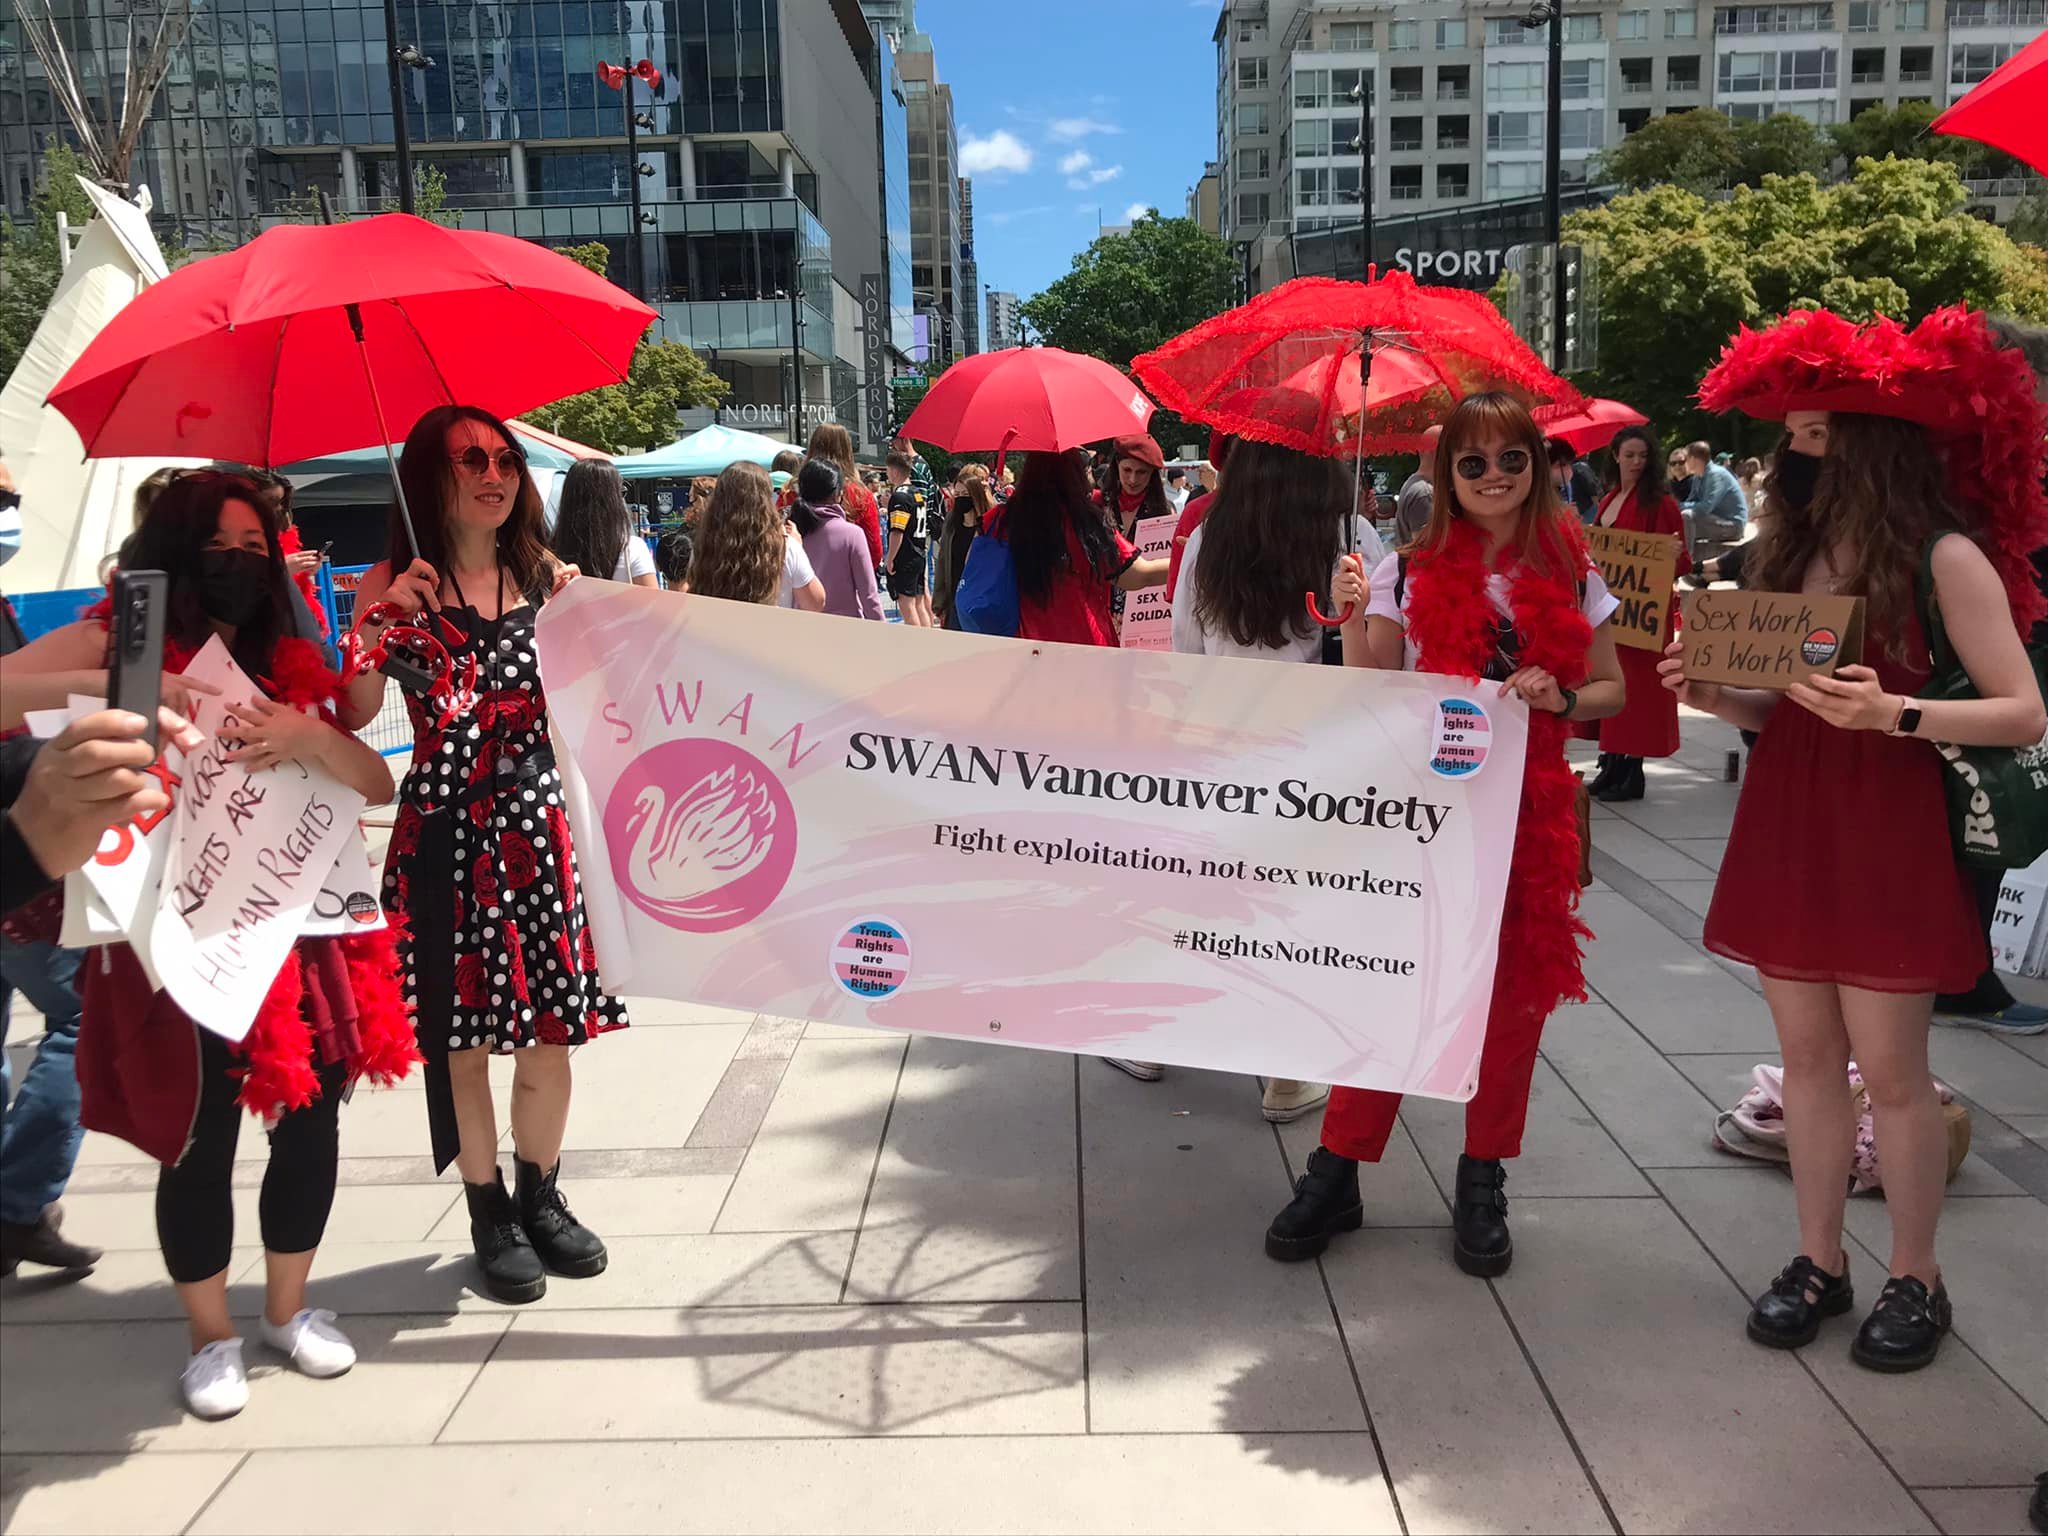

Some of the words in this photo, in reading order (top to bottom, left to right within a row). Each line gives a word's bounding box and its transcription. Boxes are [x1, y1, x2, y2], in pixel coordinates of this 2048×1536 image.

[1137, 592, 1159, 605] SEX
[1690, 594, 1740, 632] Sex
[1748, 600, 1813, 634] Work
[1692, 643, 1712, 667] is
[1727, 640, 1794, 674] Work
[601, 680, 823, 770] SWAN
[1443, 733, 1465, 742] are
[1437, 746, 1475, 757] uman
[1434, 757, 1472, 771] Rights
[846, 731, 1008, 787] SWAN
[1012, 750, 1269, 816] Vancouver
[1275, 779, 1453, 844] Society
[224, 774, 268, 837] ARE
[933, 823, 1008, 856] Fight
[1013, 837, 1193, 879] exploitation,
[1199, 859, 1247, 881] not
[1253, 865, 1299, 886] sex
[1306, 868, 1423, 899] workers
[191, 883, 281, 996] HUMAN
[256, 790, 336, 891] RIGHTS
[860, 925, 893, 939] Trans
[855, 938, 894, 953] Rights
[1173, 929, 1416, 977] #RightsNotRescue
[862, 954, 883, 965] are
[850, 964, 893, 979] Human
[851, 978, 889, 993] Rights
